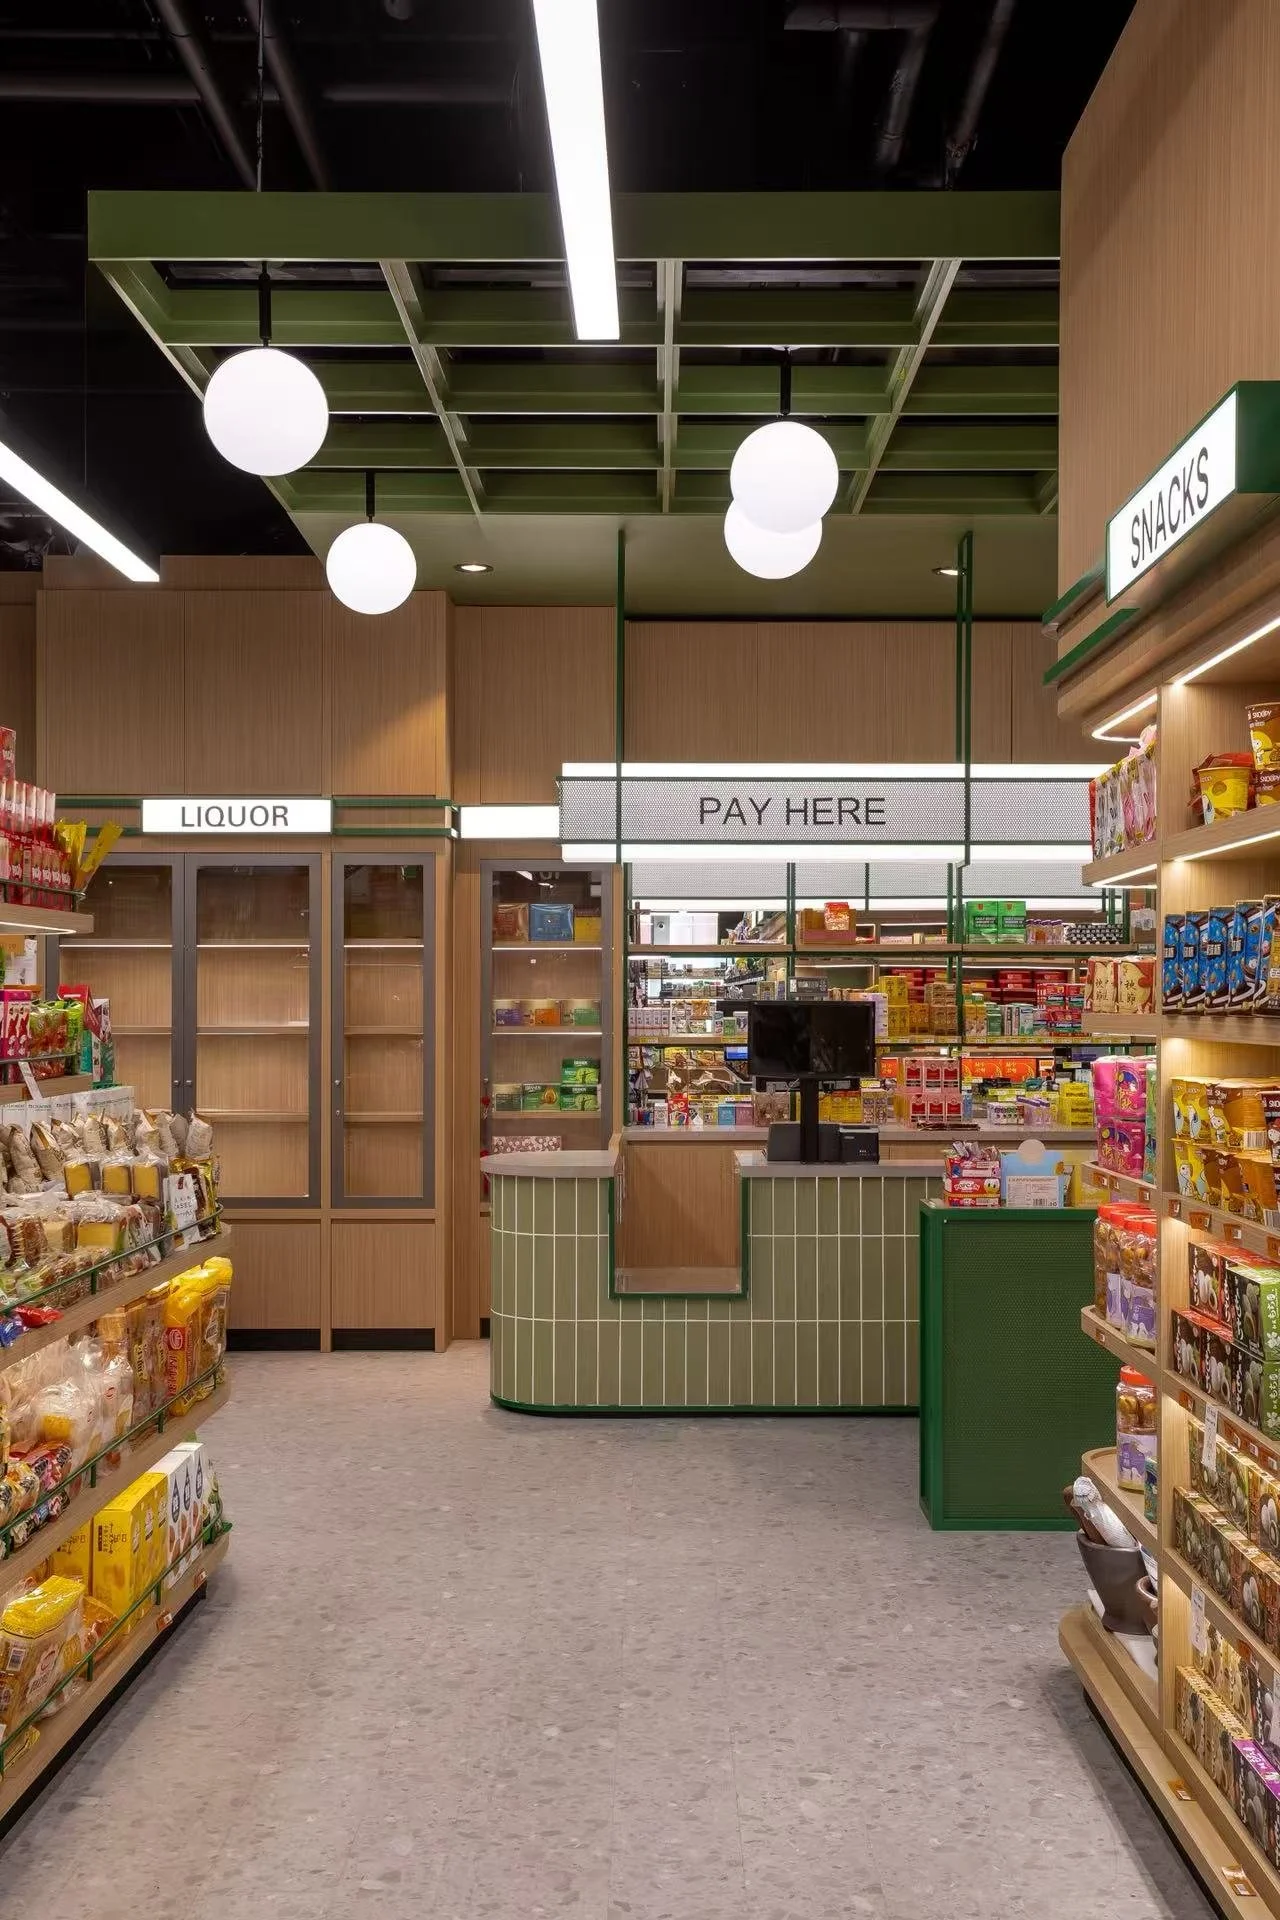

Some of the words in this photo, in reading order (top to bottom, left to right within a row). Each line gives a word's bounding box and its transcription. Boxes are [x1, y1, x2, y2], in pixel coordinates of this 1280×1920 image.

[1131, 446, 1209, 569] SNACKS
[181, 805, 289, 828] LIQUOR
[699, 796, 772, 826] PAY
[785, 796, 887, 826] HERE
